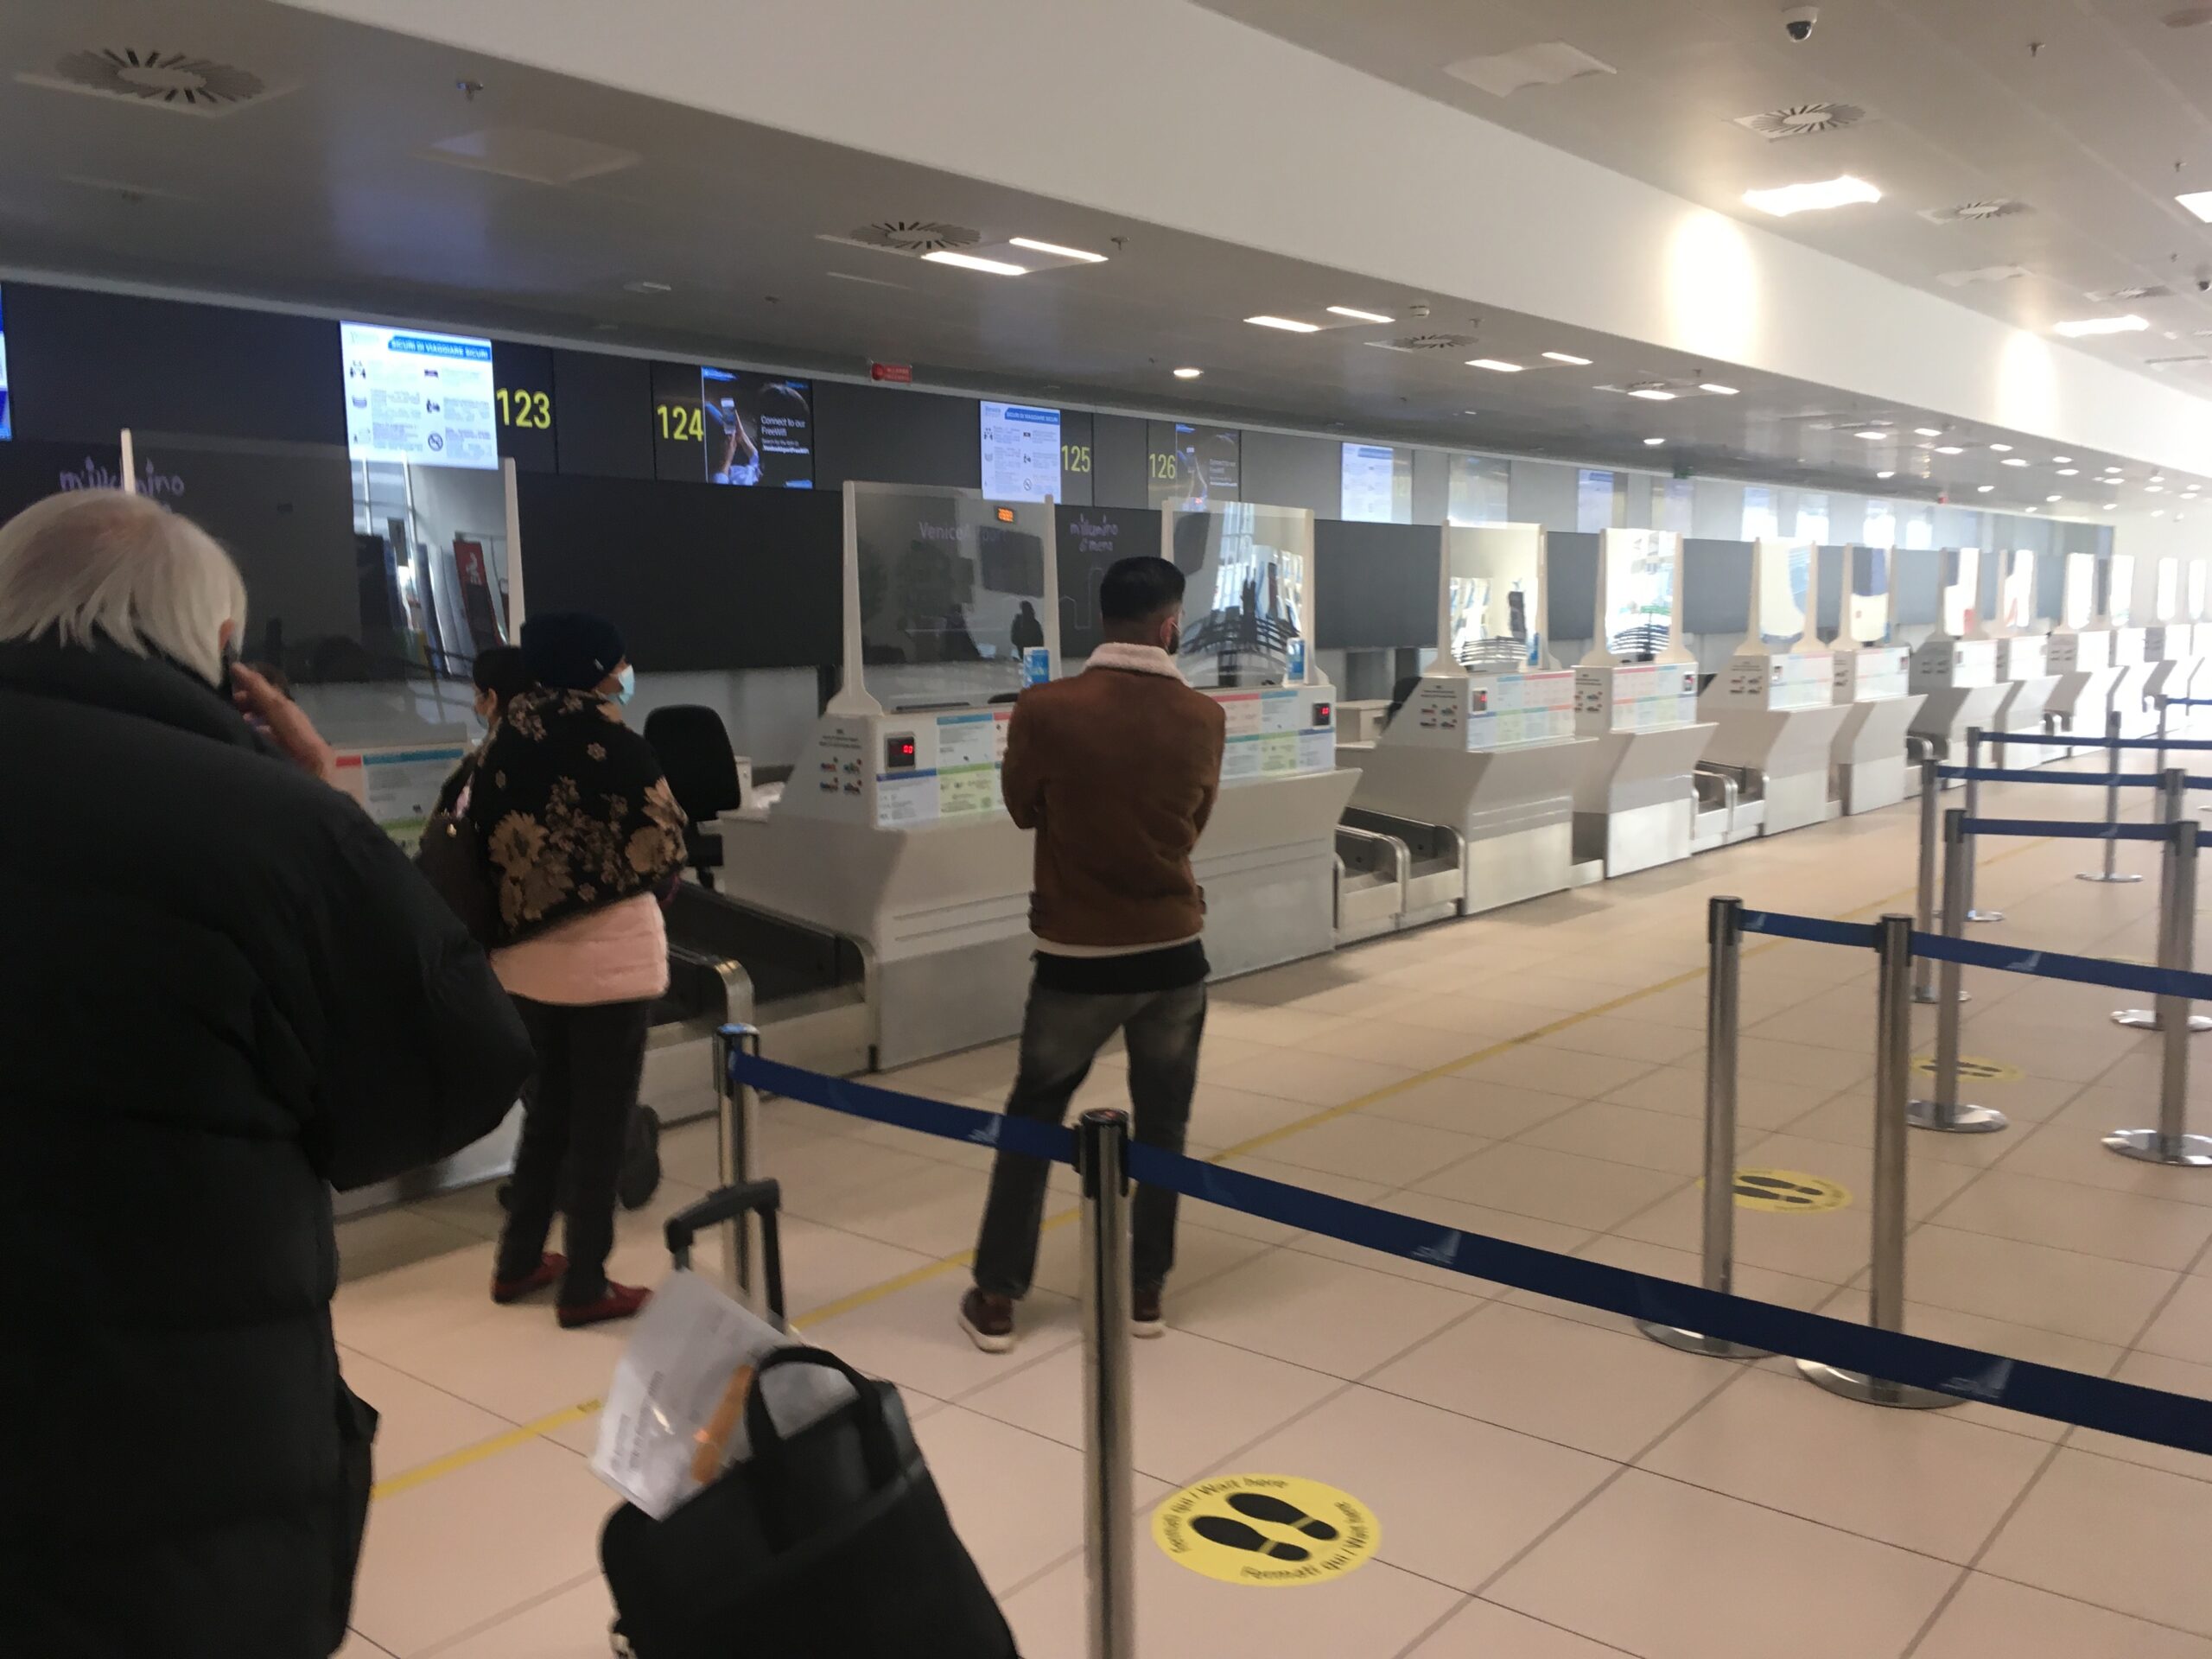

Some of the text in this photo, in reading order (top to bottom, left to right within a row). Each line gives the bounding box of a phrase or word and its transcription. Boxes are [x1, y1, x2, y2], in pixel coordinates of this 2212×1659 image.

[497, 387, 551, 429] 123
[657, 404, 704, 442] 124
[760, 415, 787, 428] Connect
[787, 418, 795, 428] to
[1061, 445, 1091, 473] 125
[1149, 454, 1176, 479] 126
[1196, 1479, 1243, 1496] Wait
